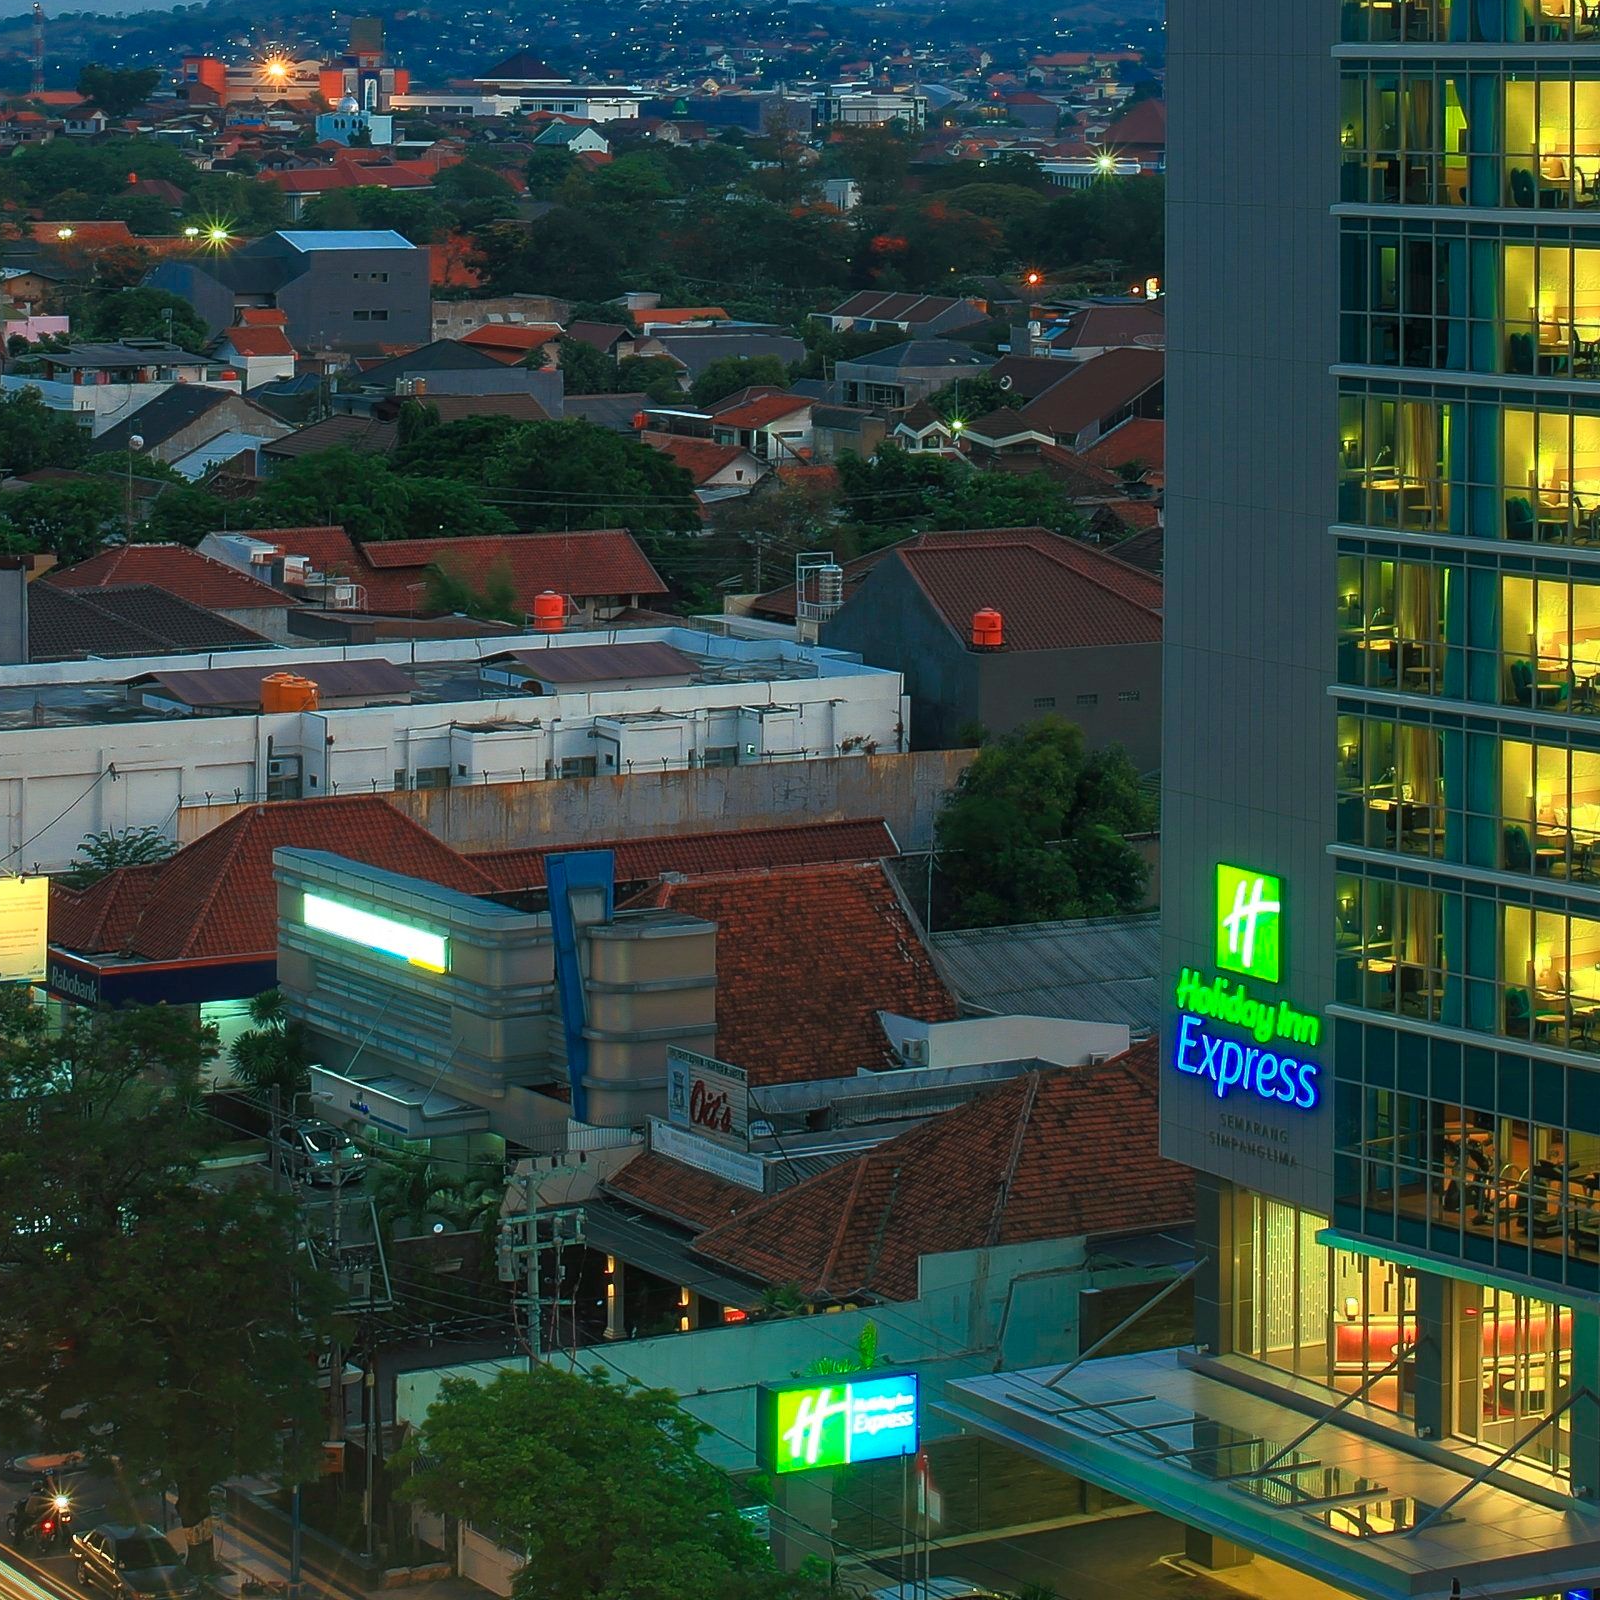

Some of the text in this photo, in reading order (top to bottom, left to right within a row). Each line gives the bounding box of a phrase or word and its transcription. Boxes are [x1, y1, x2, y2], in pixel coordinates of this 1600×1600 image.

[51, 965, 97, 1003] Rabobank
[1176, 967, 1321, 1046] Holiday Inn
[1176, 1014, 1320, 1111] Express
[1219, 1113, 1289, 1144] SEMARANG
[853, 1410, 914, 1435] Express
